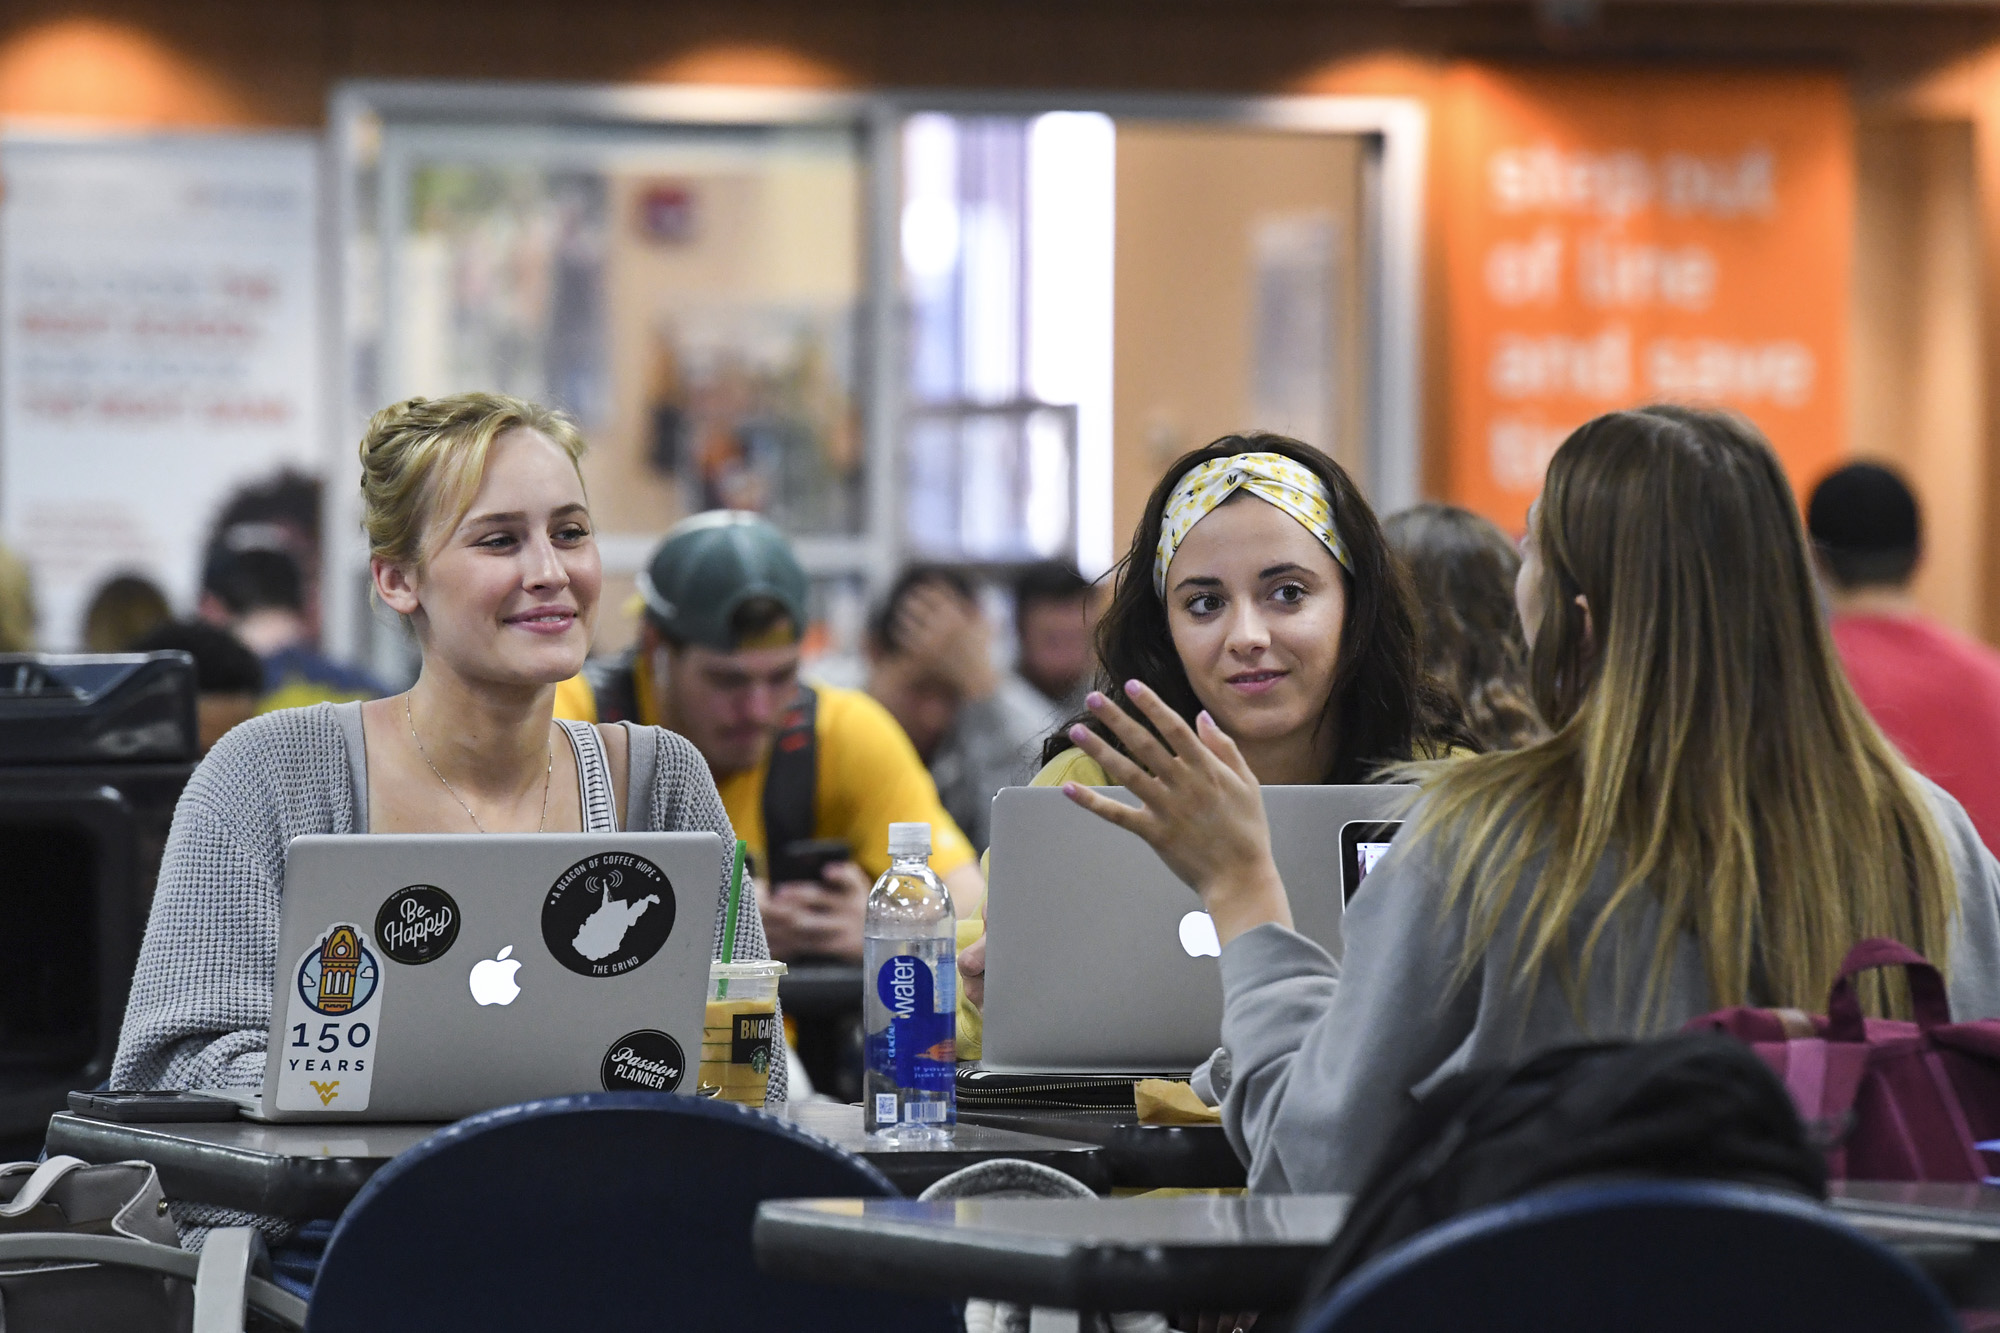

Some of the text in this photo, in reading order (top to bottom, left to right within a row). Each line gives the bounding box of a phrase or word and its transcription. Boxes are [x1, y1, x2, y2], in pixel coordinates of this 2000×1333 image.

[1491, 140, 1776, 230] step out
[1485, 228, 1718, 310] of line
[1489, 322, 1815, 408] and save
[557, 864, 587, 891] BEACON
[588, 858, 600, 869] OF
[603, 855, 635, 867] COFFEE
[635, 861, 657, 878] HOPE
[400, 898, 431, 924] Be
[384, 906, 452, 951] Happy
[592, 956, 640, 974] THE GRIND
[890, 957, 915, 1015] water
[291, 1022, 371, 1053] 150
[289, 1059, 365, 1071] YEARS
[611, 1046, 679, 1079] Passion
[614, 1064, 666, 1090] PLANNER
